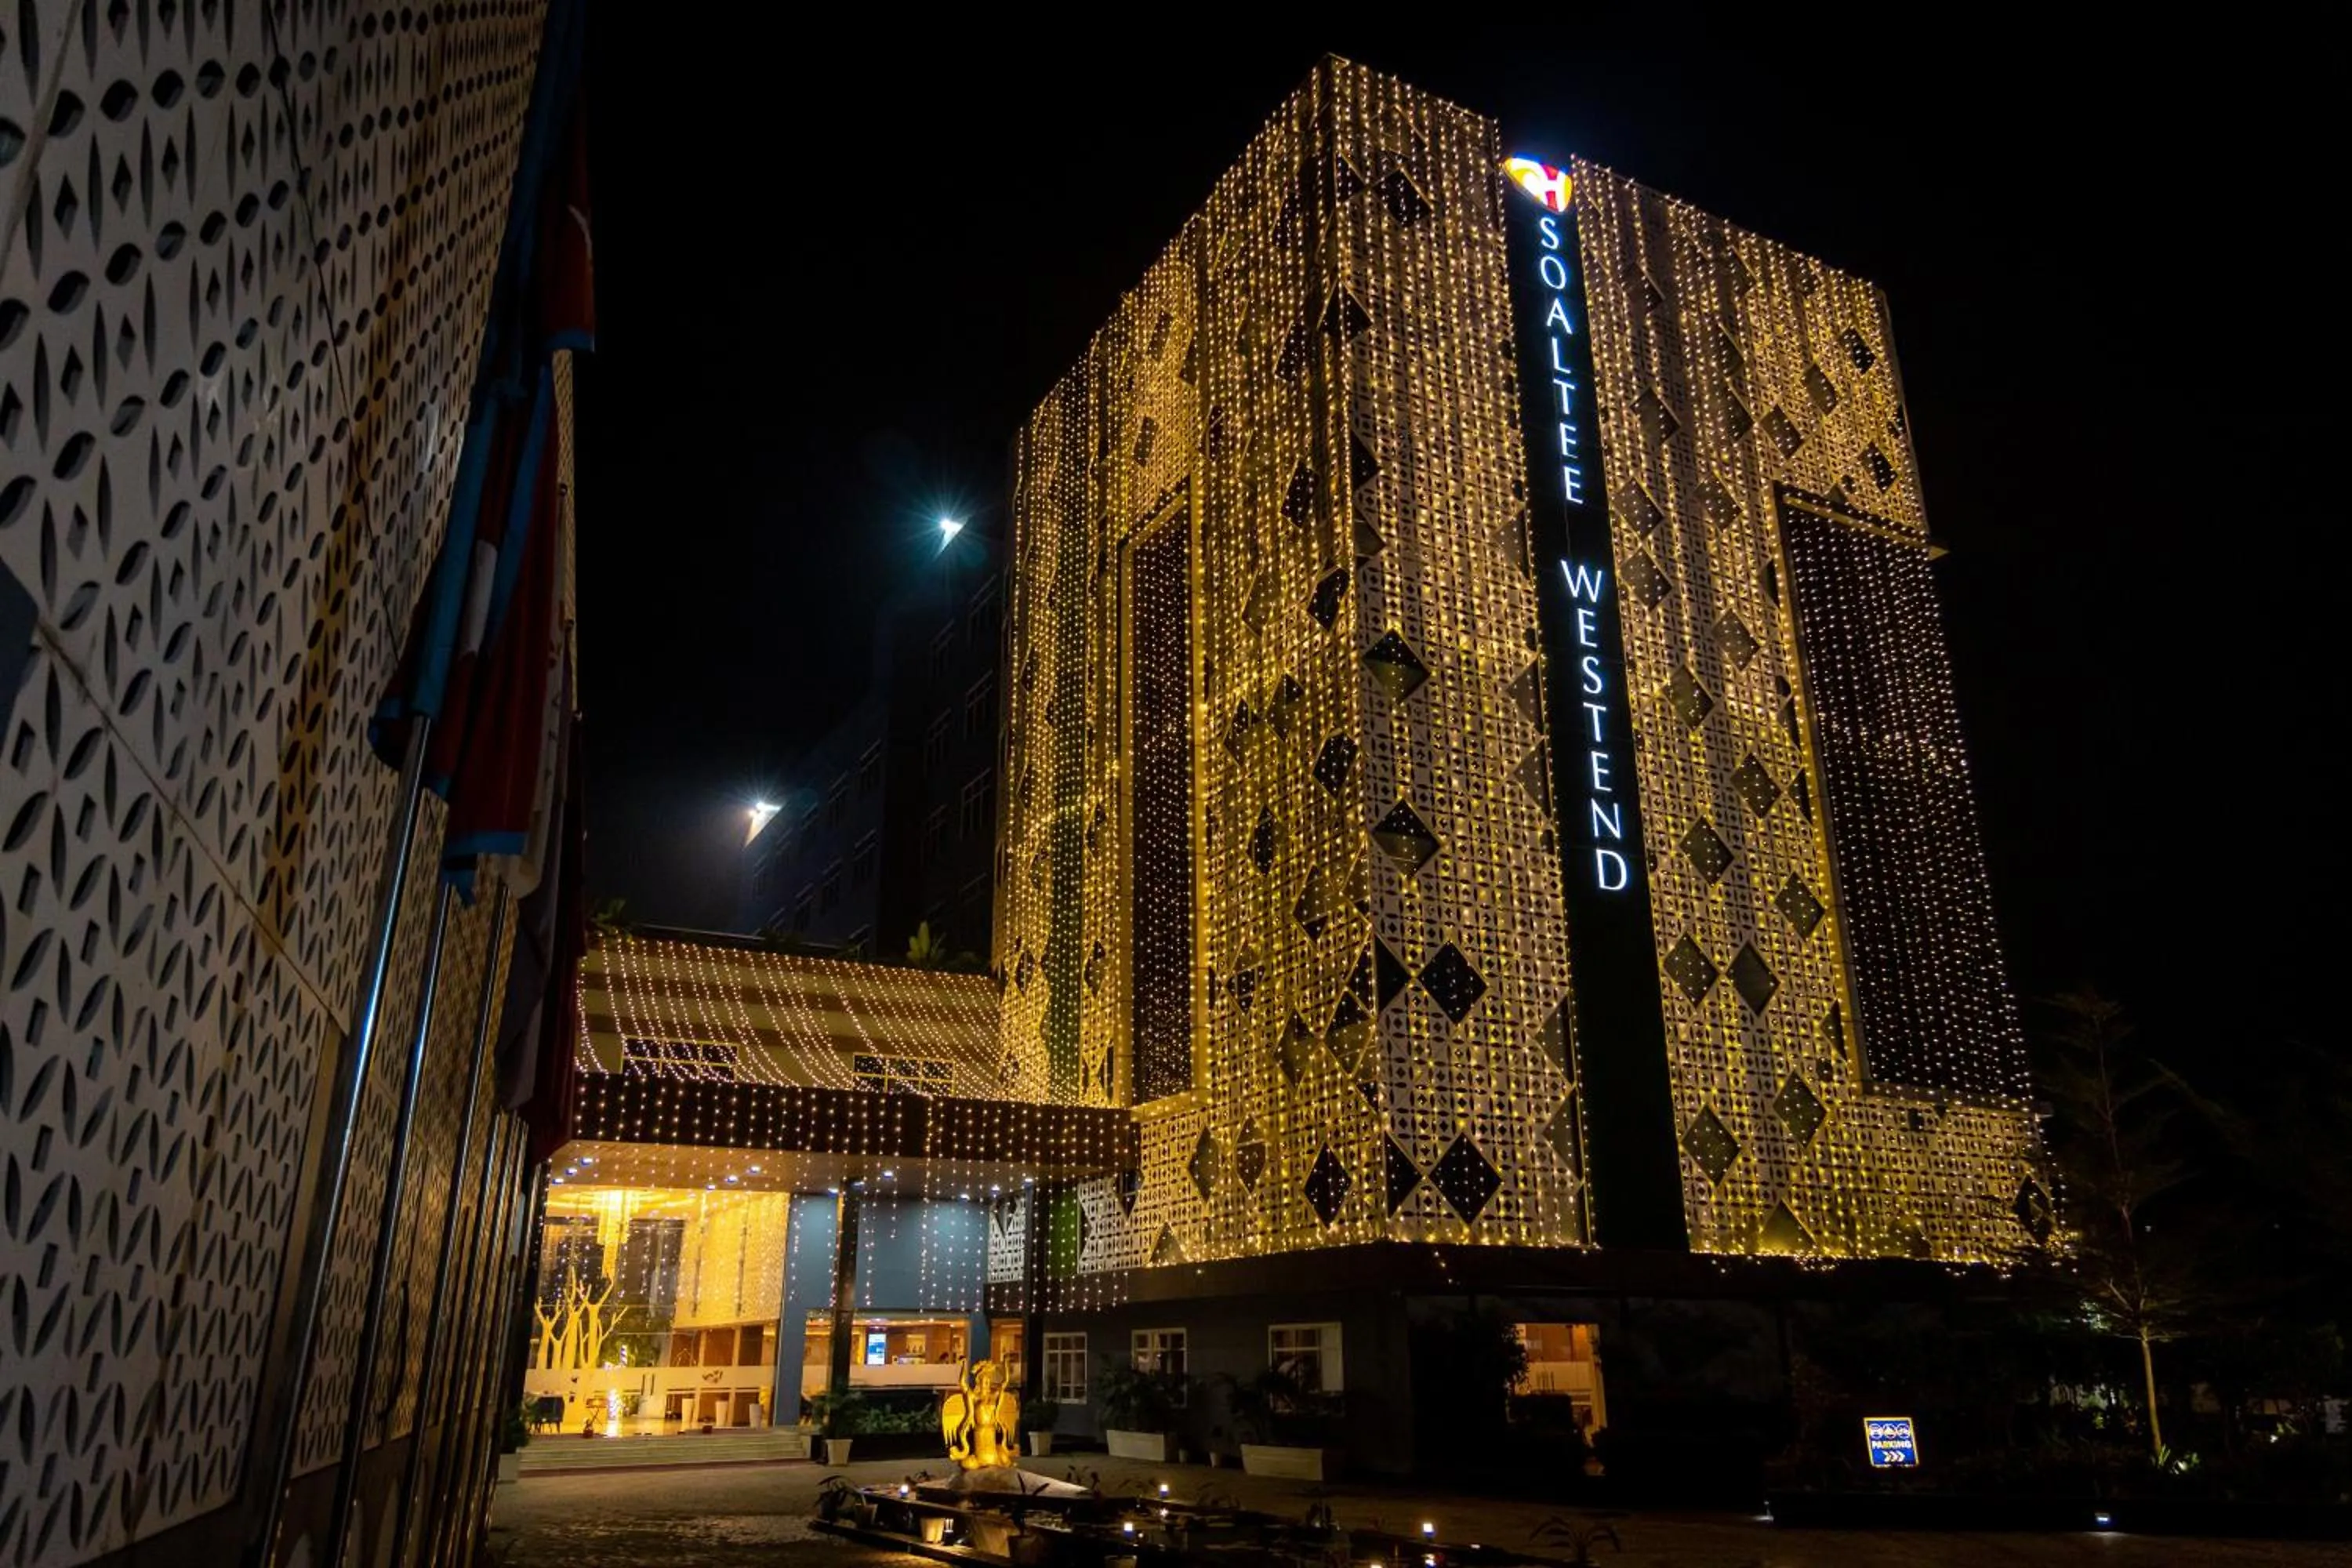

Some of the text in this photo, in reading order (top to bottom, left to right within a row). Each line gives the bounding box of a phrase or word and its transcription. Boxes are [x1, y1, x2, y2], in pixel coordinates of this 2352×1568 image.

[1539, 216, 1628, 891] SOALTEE WESTEND
[1871, 1440, 1912, 1449] PARKING
